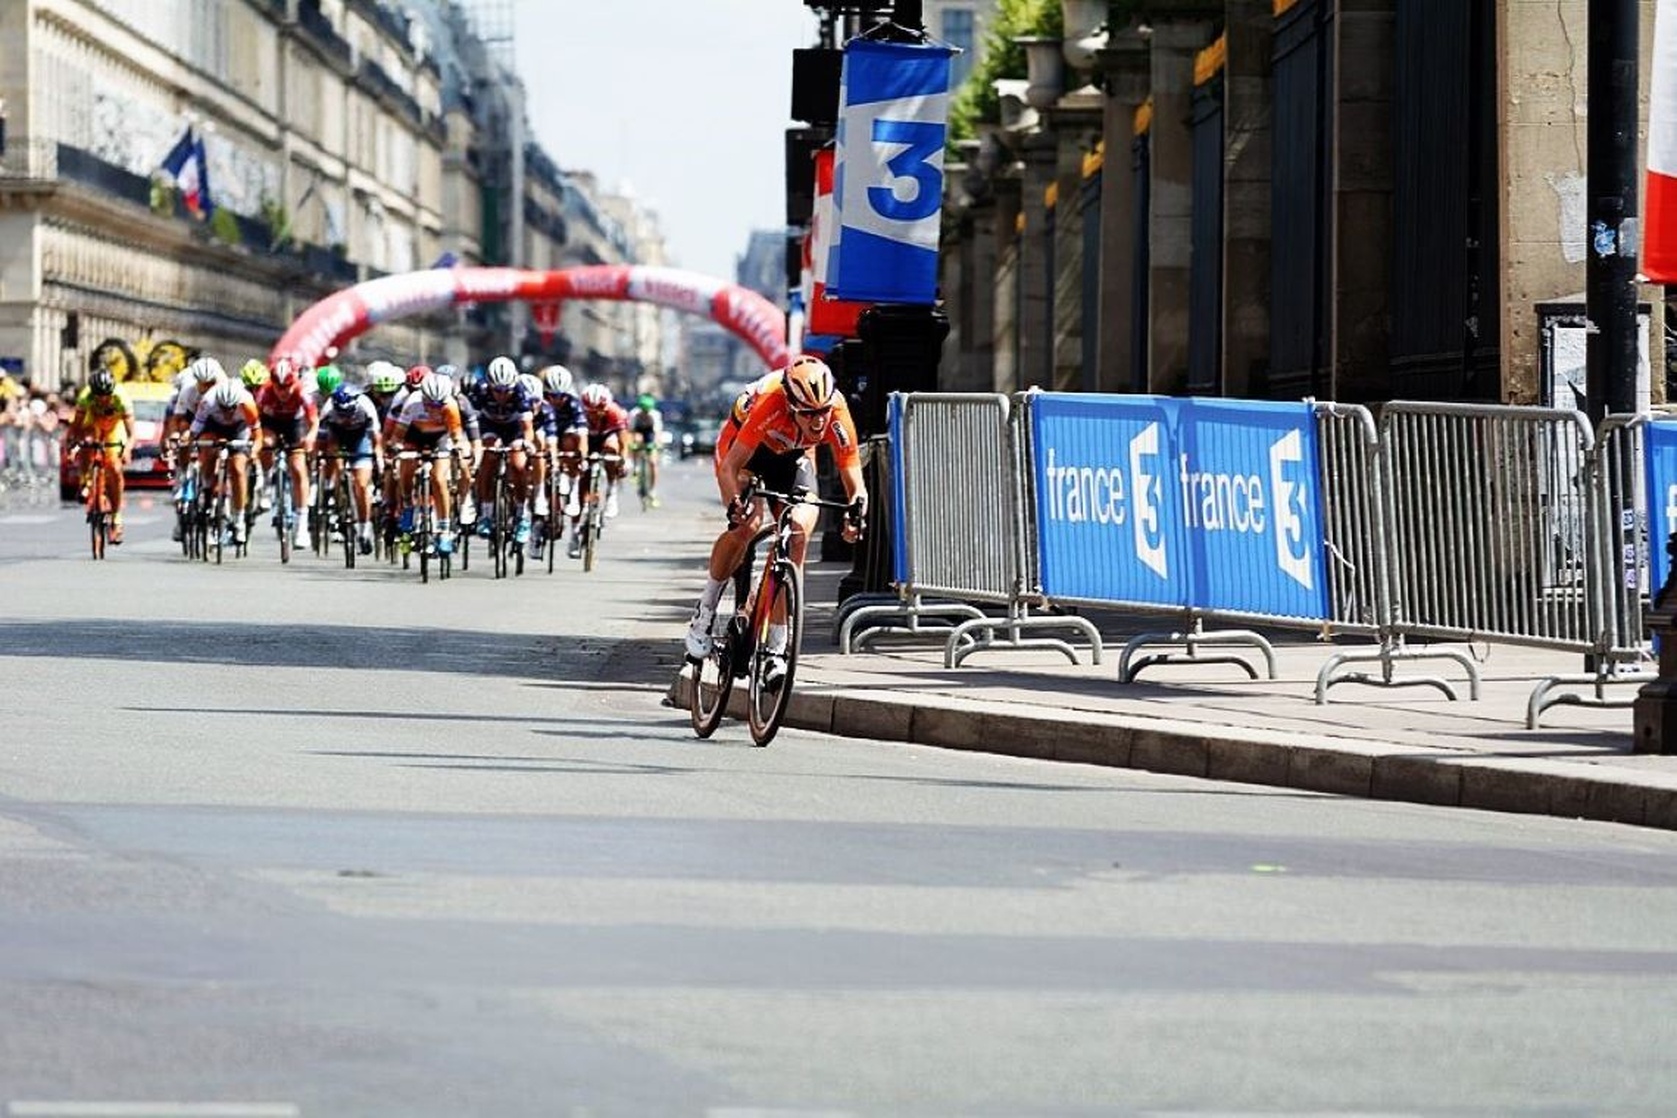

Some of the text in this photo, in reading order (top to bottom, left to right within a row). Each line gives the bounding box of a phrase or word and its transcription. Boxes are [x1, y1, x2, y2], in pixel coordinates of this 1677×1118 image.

[867, 119, 946, 221] 3
[1047, 448, 1125, 525] france
[1180, 453, 1265, 533] france
